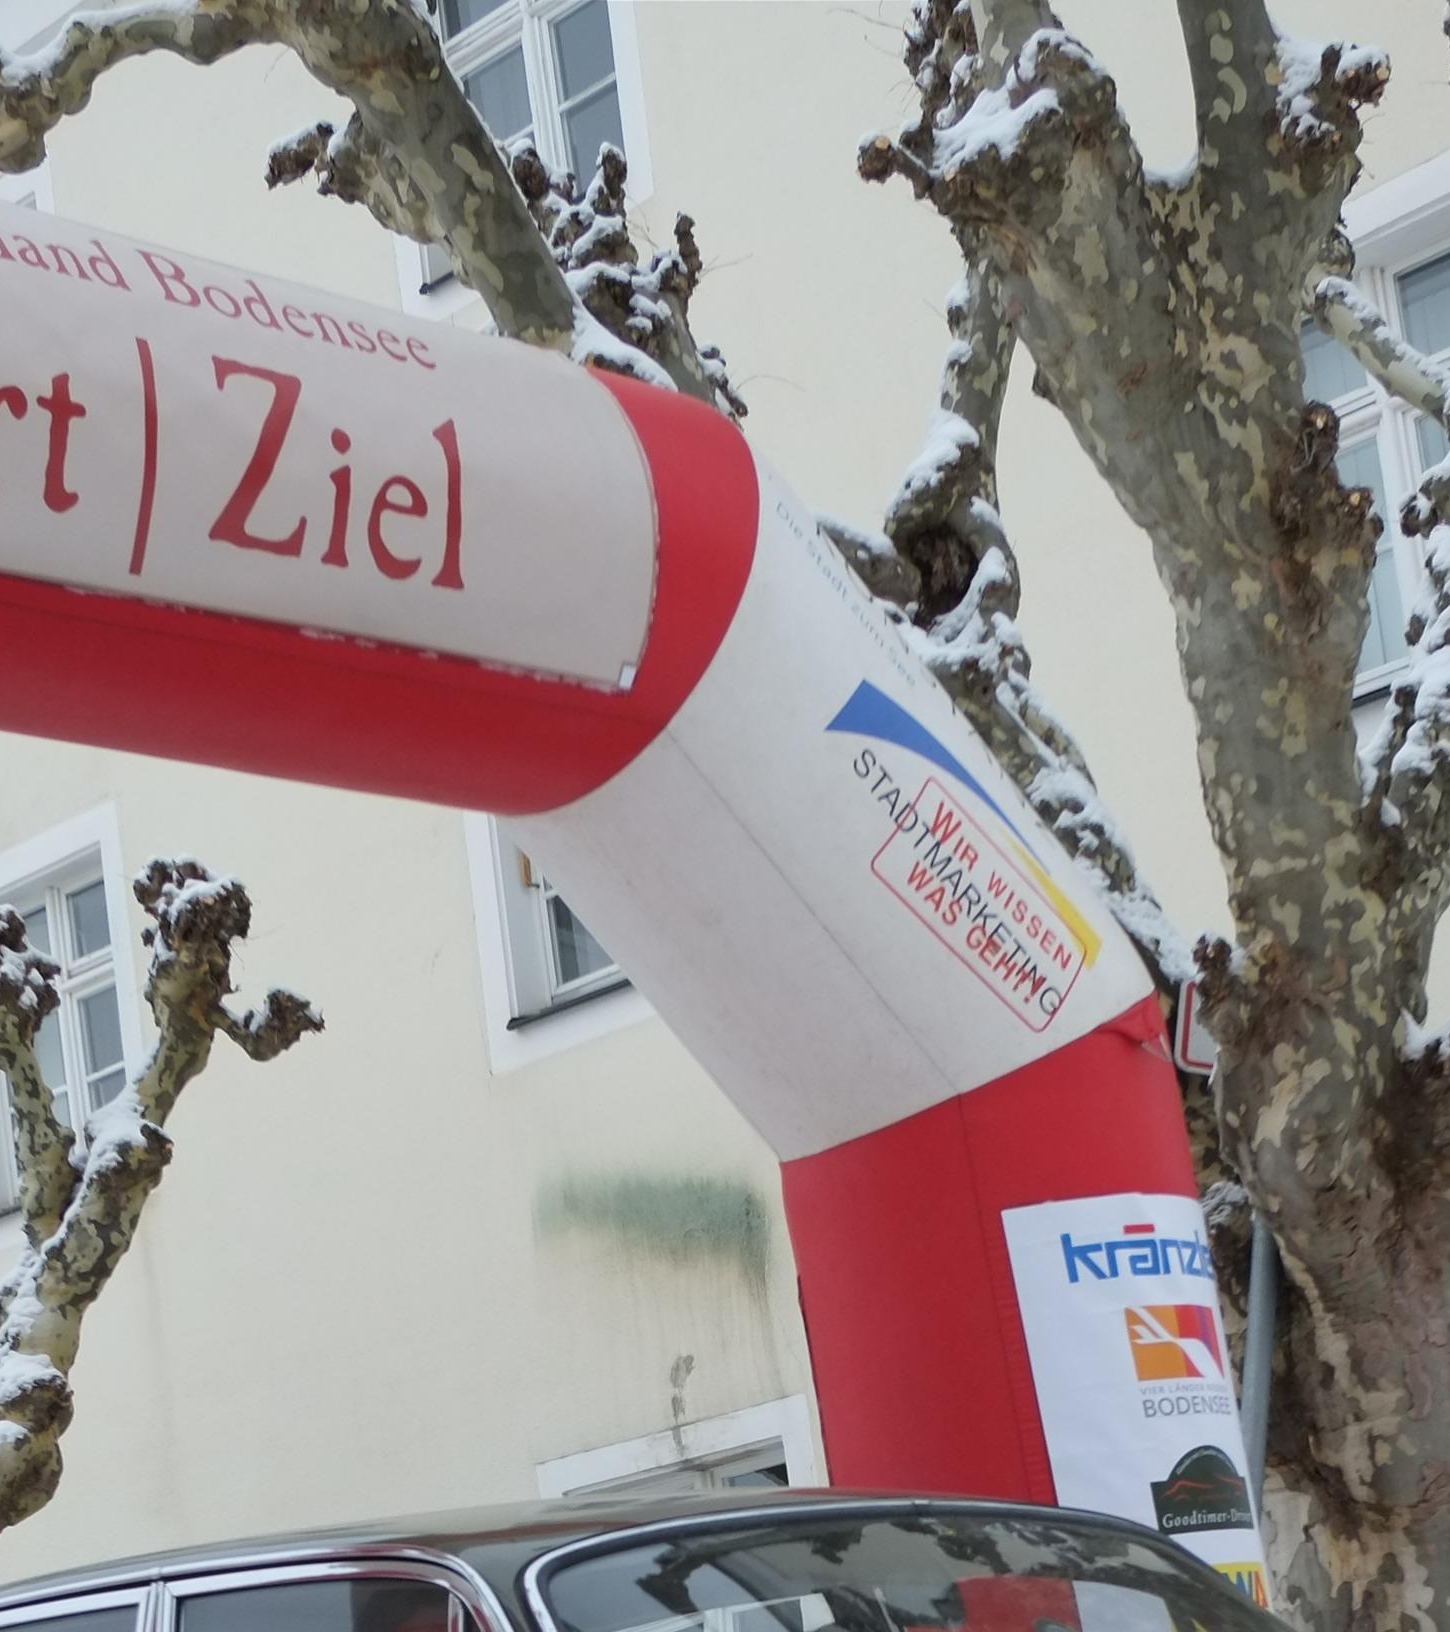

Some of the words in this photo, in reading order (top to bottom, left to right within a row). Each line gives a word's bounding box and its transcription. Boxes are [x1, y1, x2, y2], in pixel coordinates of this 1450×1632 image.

[135, 249, 438, 370] Bodensee
[209, 355, 466, 591] Ziel
[853, 748, 1063, 1016] STADTMARKETING
[907, 861, 963, 926] WAS
[930, 801, 979, 872] WIR
[987, 870, 1072, 971] WISSEN
